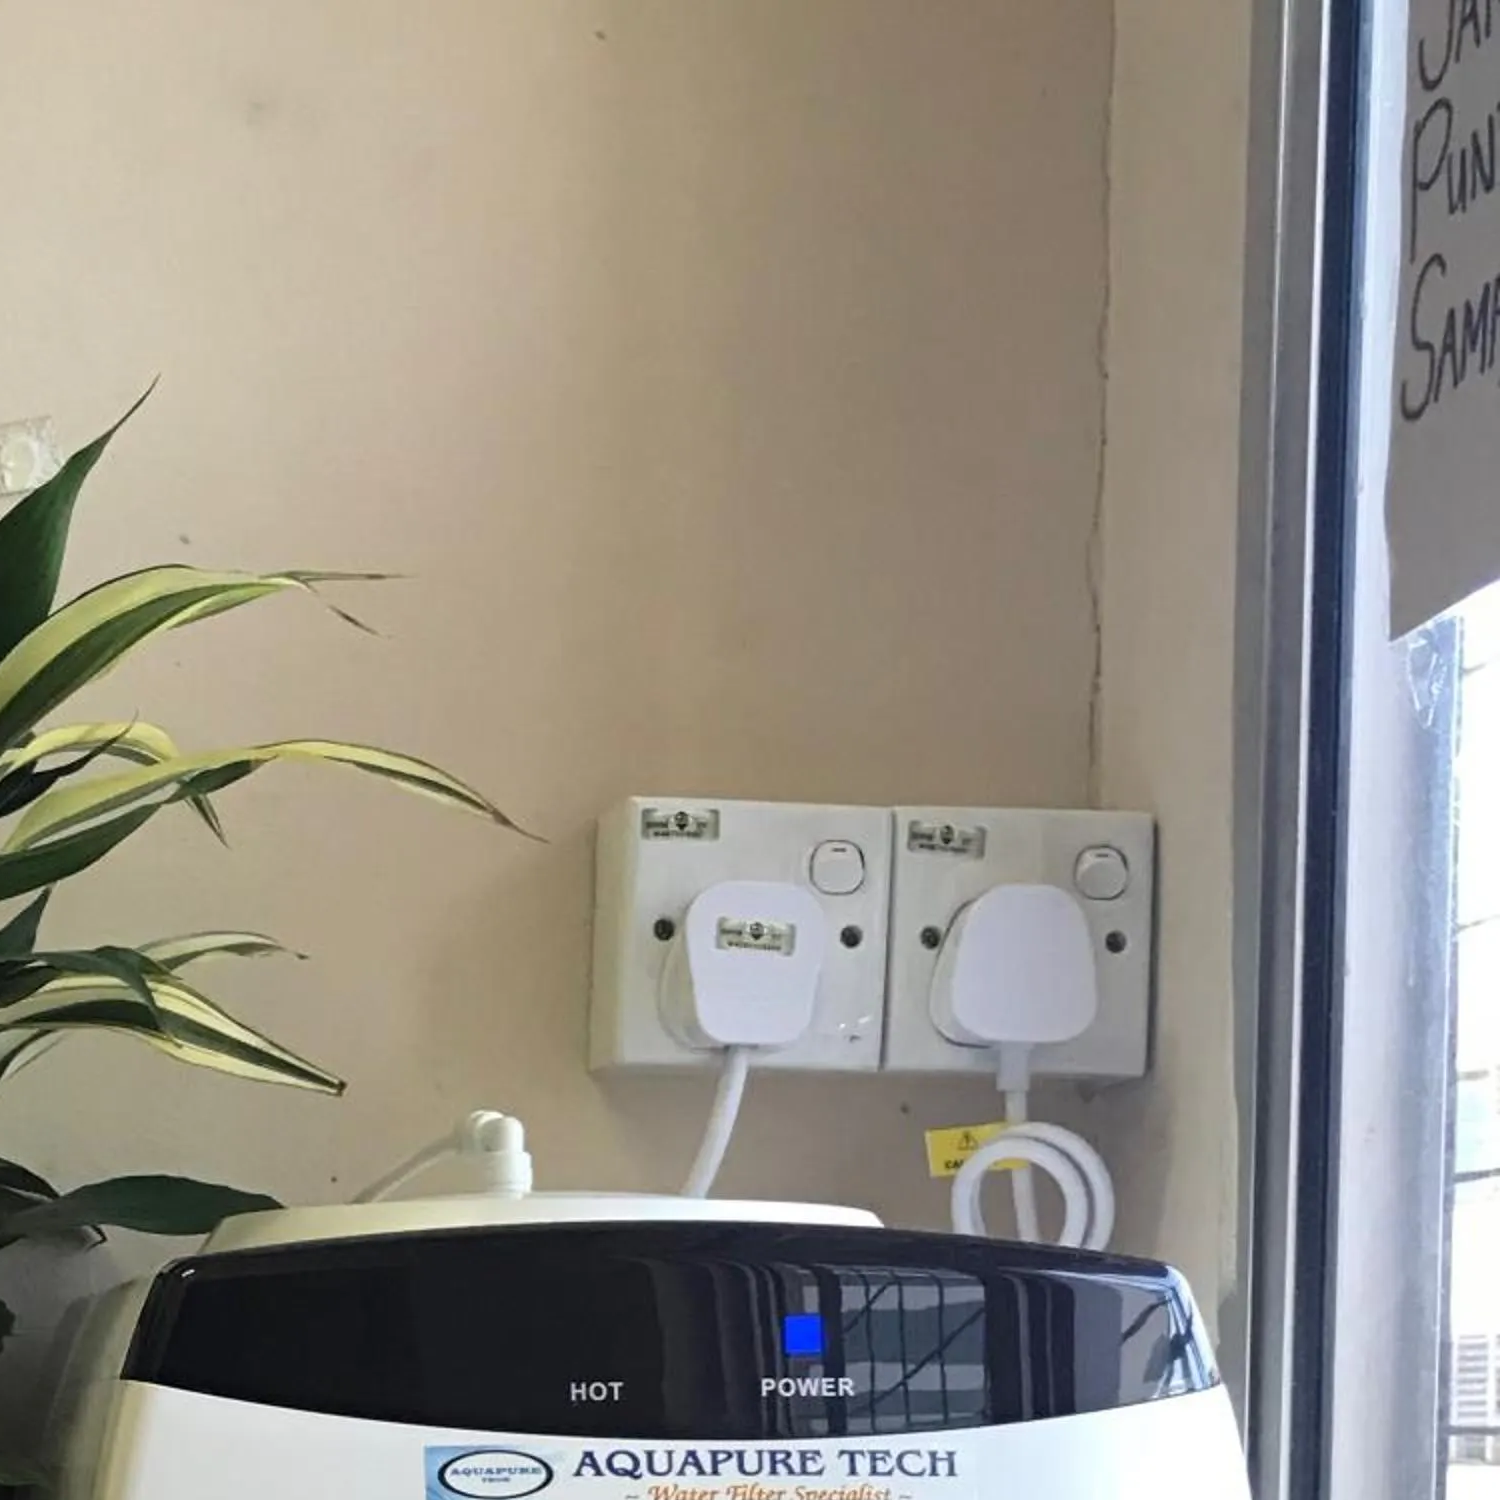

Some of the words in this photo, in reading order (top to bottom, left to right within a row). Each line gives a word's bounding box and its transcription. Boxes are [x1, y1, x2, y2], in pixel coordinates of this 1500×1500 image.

[1419, 0, 1500, 92] JA
[1410, 97, 1500, 265] PUN
[570, 1382, 624, 1401] HOT
[760, 1378, 855, 1397] POWER
[572, 1450, 826, 1480] AQUAPURE
[837, 1450, 957, 1477] TECH
